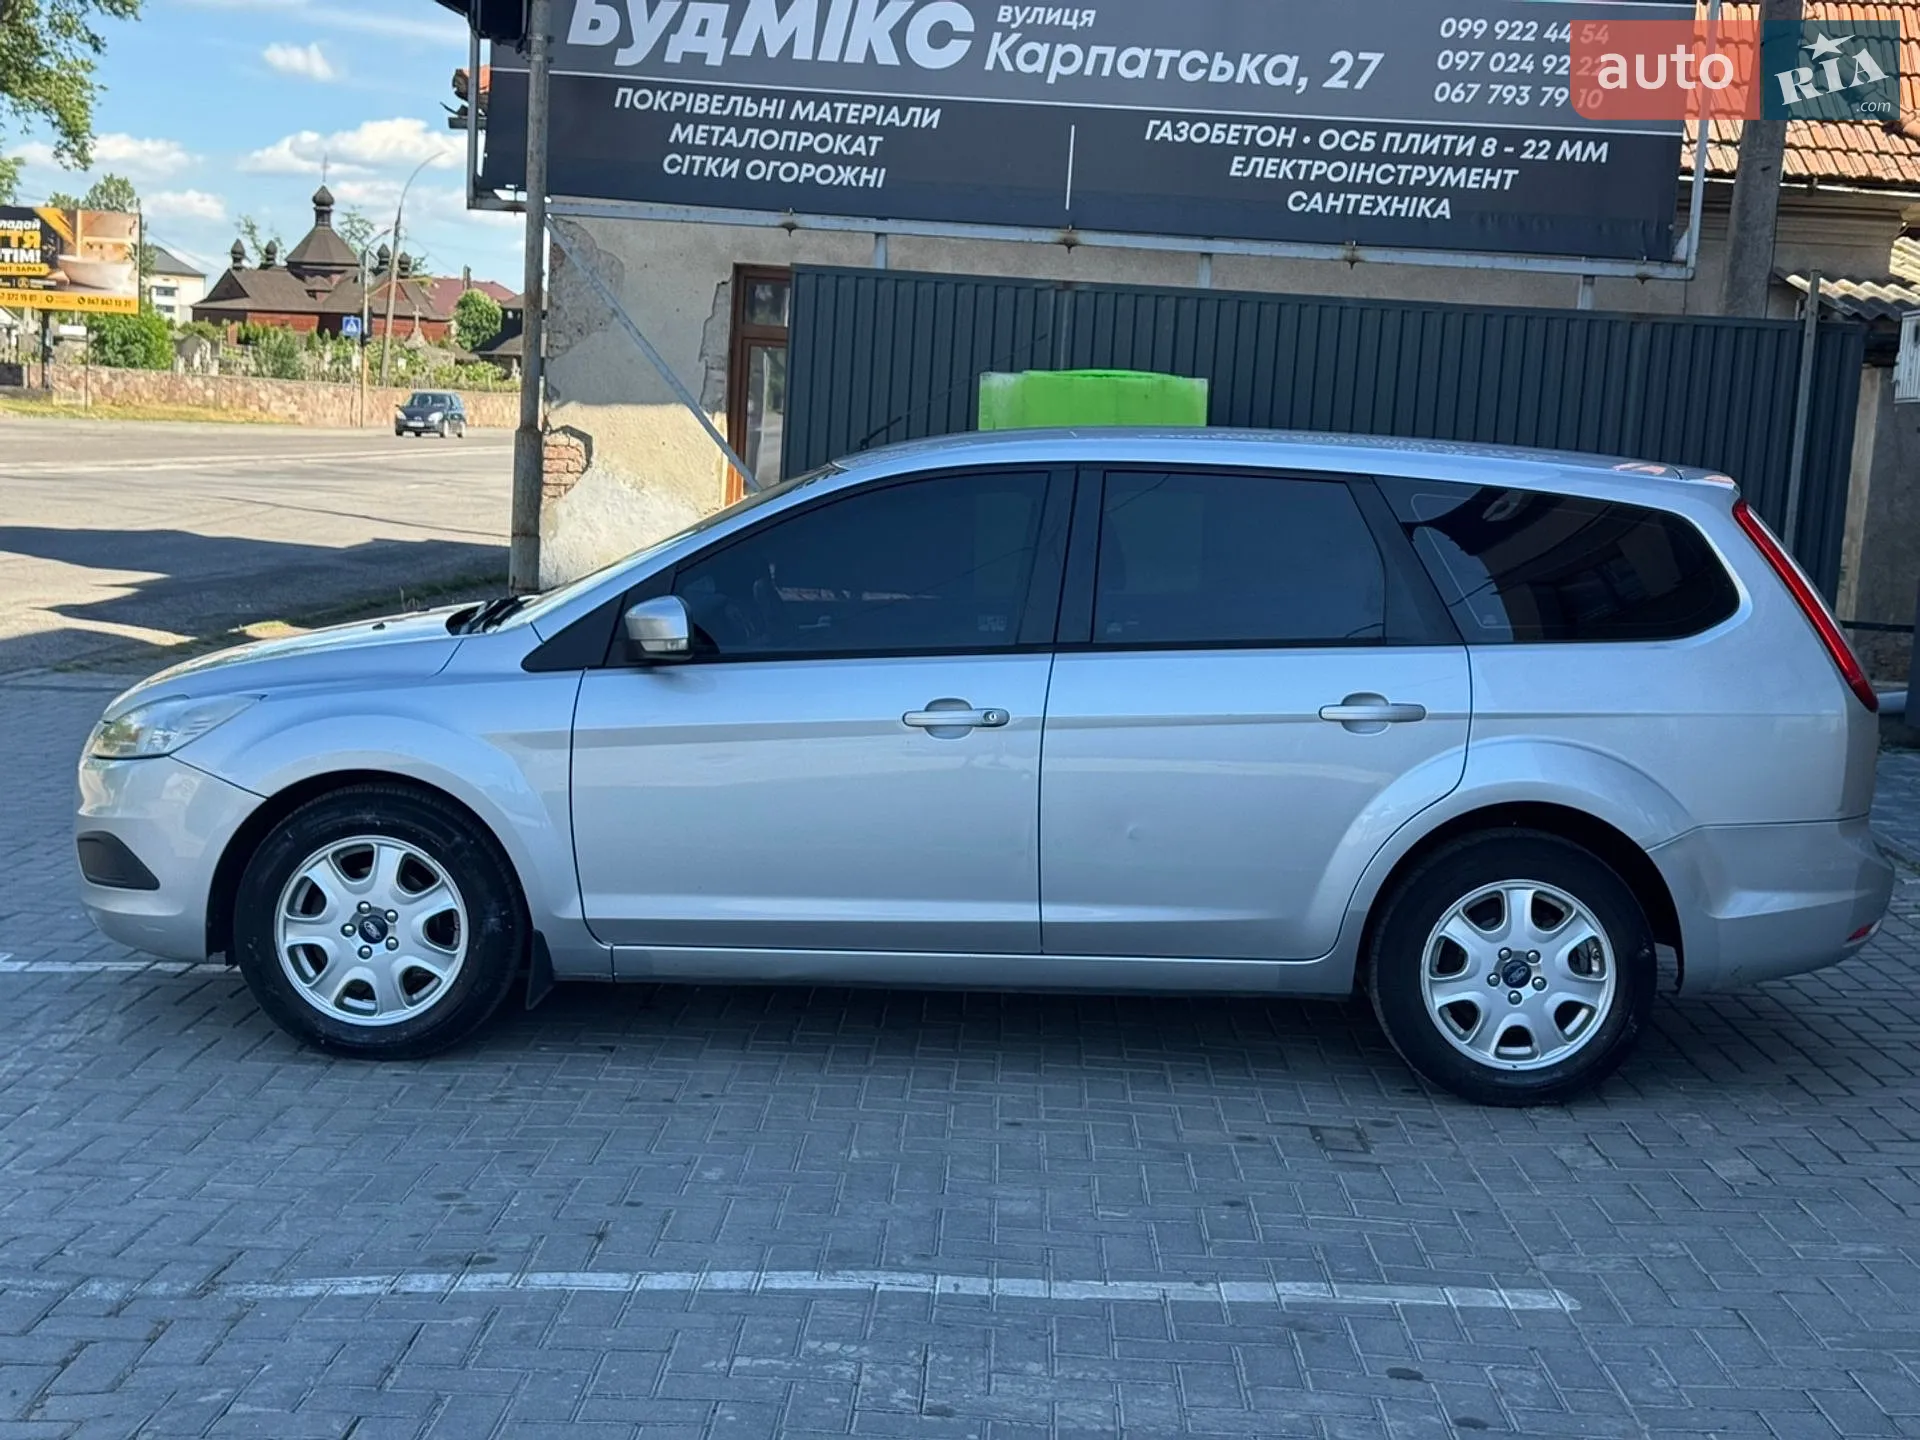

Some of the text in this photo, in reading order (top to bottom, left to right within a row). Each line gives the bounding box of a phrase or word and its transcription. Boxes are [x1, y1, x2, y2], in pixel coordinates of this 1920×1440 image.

[996, 4, 1096, 30] вулиця
[1439, 17, 1610, 45] 099 922 44 54
[984, 31, 1385, 94] Карпатська, 27
[1437, 50, 1485, 72] 097
[1489, 52, 1535, 74] 024
[1542, 54, 1571, 76] 92
[614, 87, 942, 129] ПОКРІВЕЛЬНІ МАТЕРІАЛИ
[1434, 82, 1604, 109] 067 793 79 10
[668, 123, 884, 156] МЕТАЛОПРОКАТ
[1144, 120, 1297, 148] ГАЗОБЕТОН
[1318, 129, 1377, 153] ОСБ
[1381, 131, 1477, 157] ПЛИТИ
[1481, 136, 1498, 158] 8
[1519, 139, 1552, 160] 22
[1555, 139, 1609, 164] ММ
[662, 153, 887, 188] СІТКИ ОГОРОЖНІ
[1229, 155, 1519, 190] ЕЛЕКТРОІНСТРУМЕНТ
[1287, 190, 1451, 219] САНТЕХНІКА
